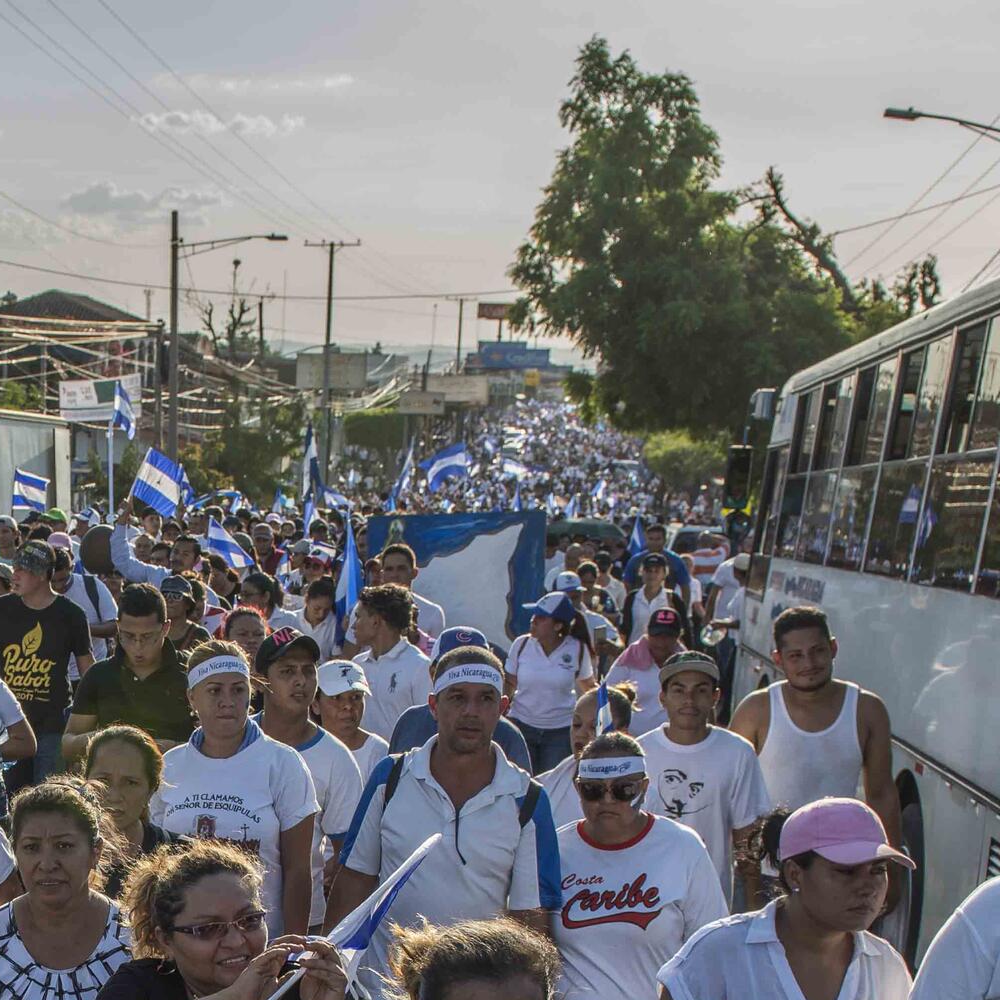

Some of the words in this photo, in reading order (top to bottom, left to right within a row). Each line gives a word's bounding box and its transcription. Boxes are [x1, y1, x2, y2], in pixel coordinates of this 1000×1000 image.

[3, 644, 57, 673] Puro
[209, 660, 240, 673] Nicaragua
[4, 664, 52, 687] Sabor
[460, 667, 493, 680] Nicaragua
[192, 793, 199, 801] TI
[200, 793, 244, 806] CLAMAMOS
[202, 801, 213, 810] DE
[214, 801, 262, 824] ESQUIPULAS
[561, 873, 605, 891] Costa
[561, 872, 662, 926] Caribe
